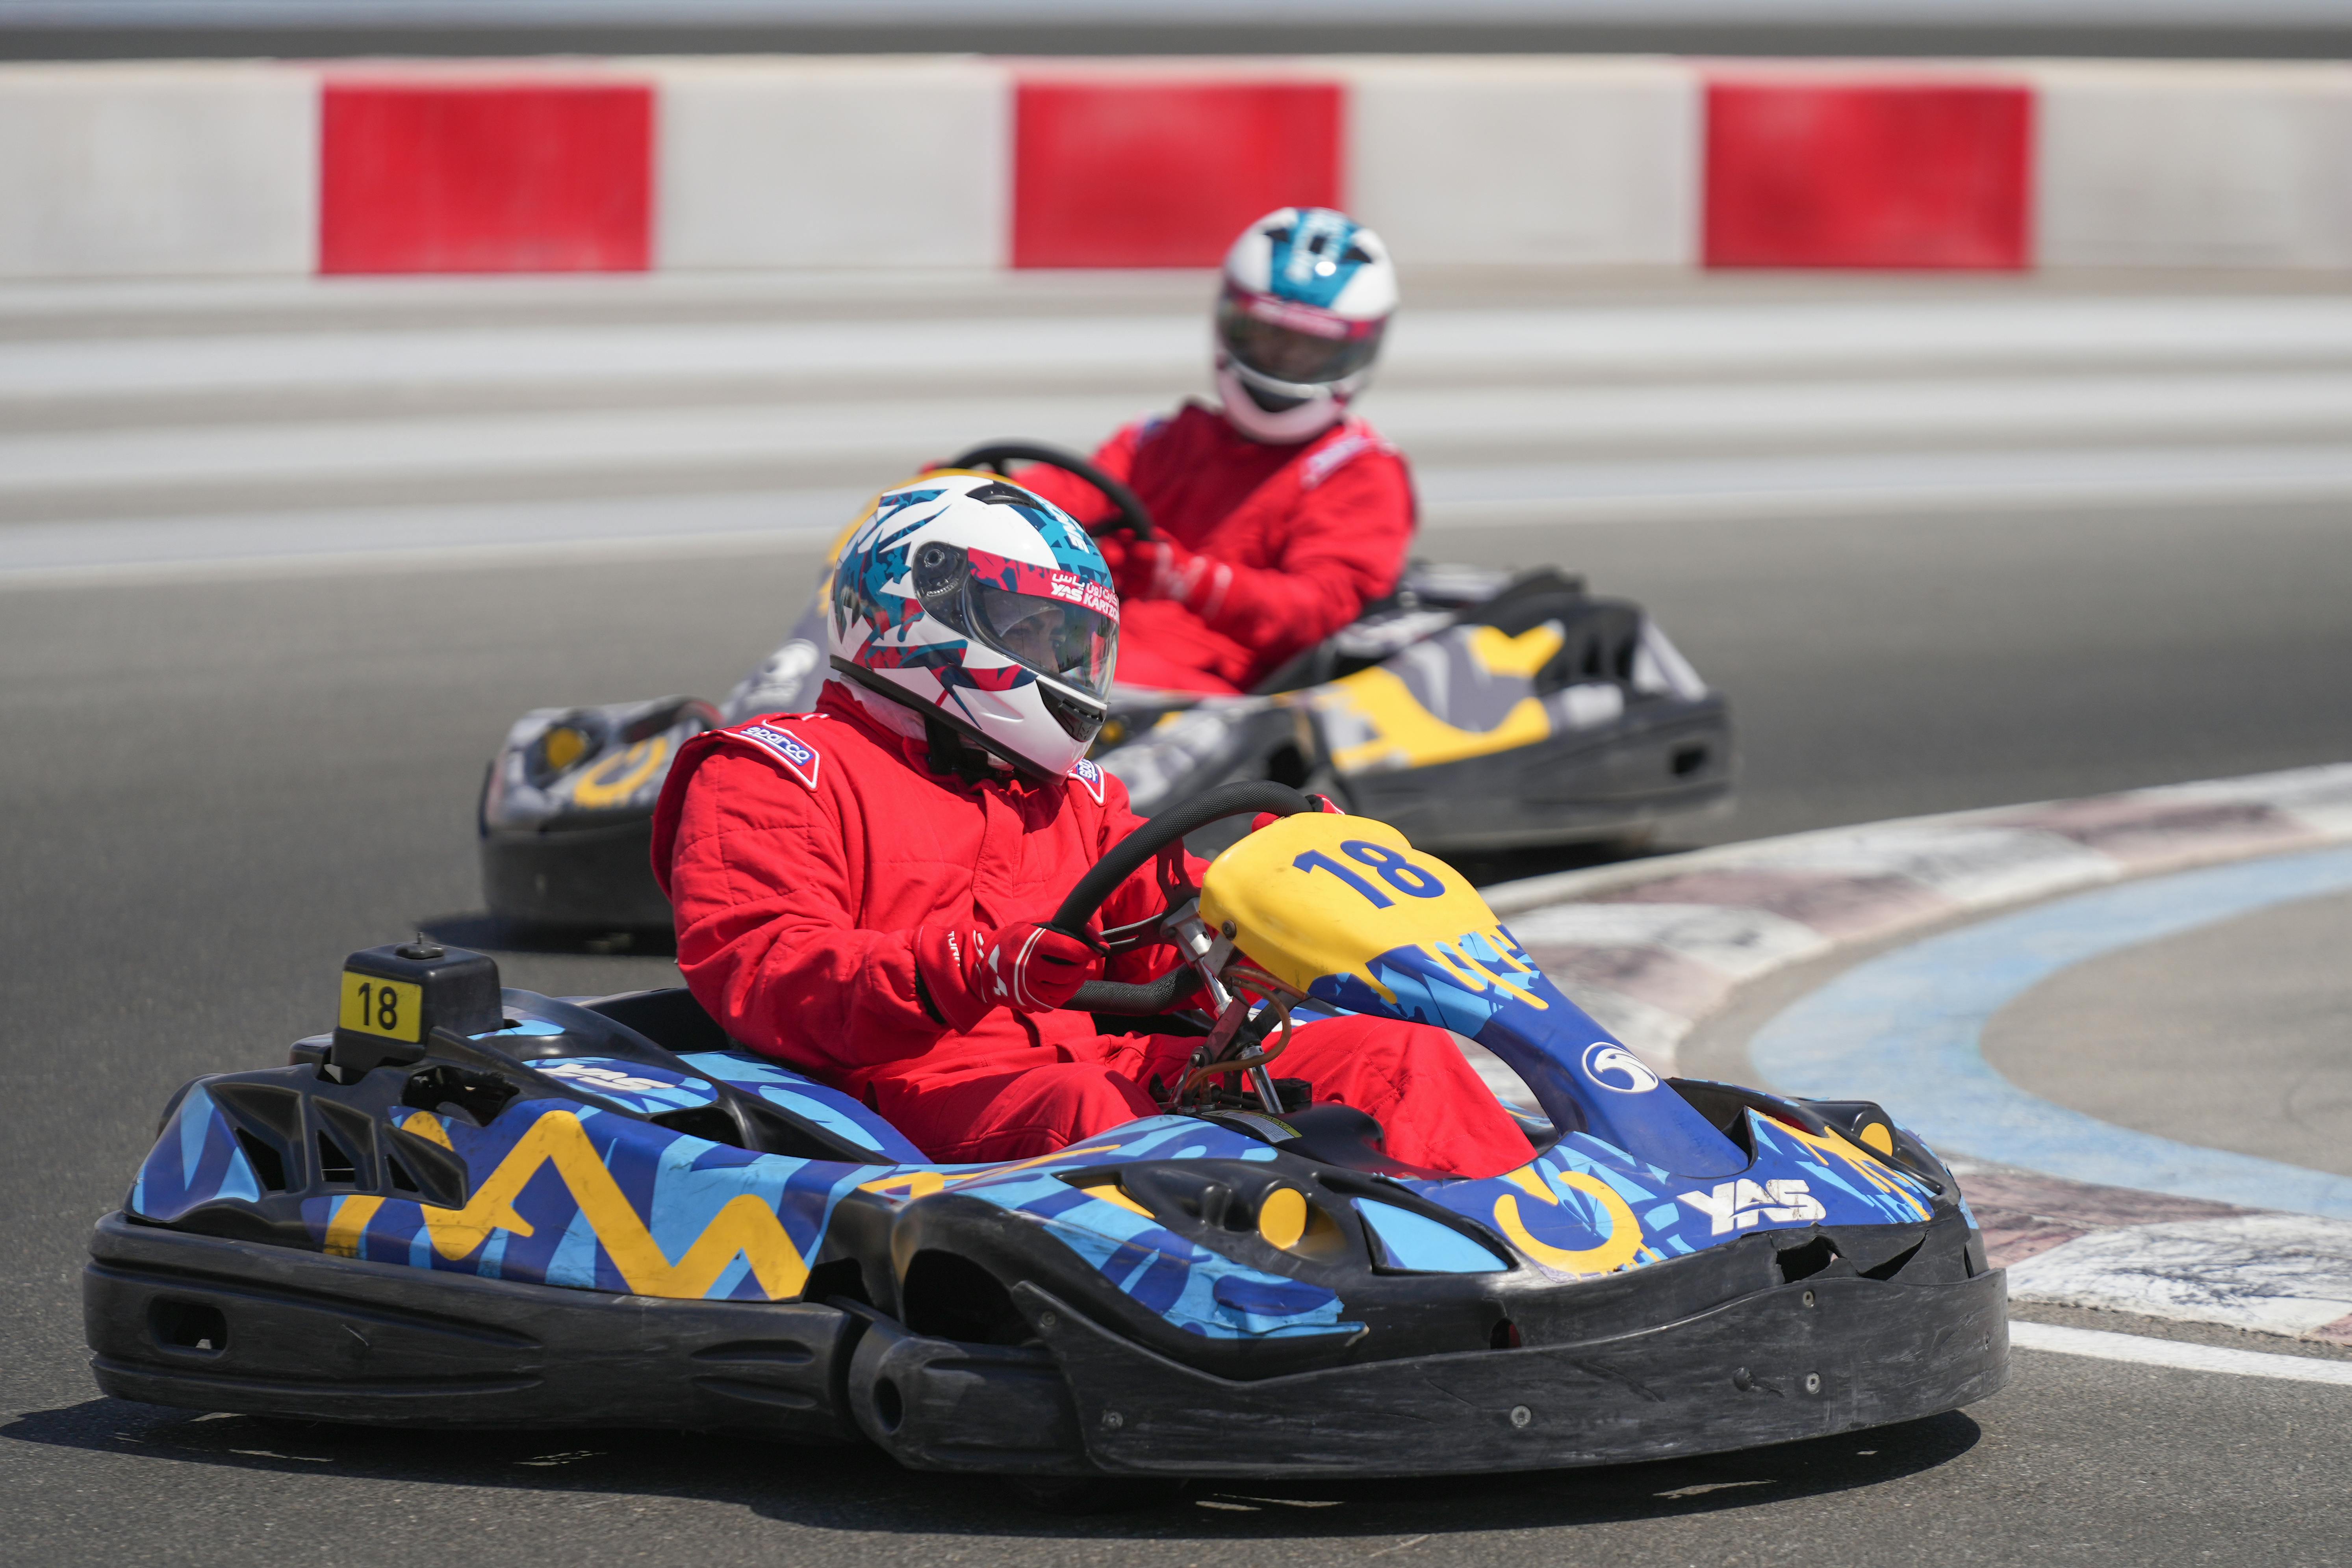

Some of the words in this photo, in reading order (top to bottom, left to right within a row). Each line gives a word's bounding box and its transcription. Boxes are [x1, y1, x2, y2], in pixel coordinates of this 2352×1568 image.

[1051, 582, 1083, 602] YAS
[1083, 592, 1119, 622] KARTZO
[1052, 573, 1085, 591] ياس
[741, 726, 811, 761] sparco
[1292, 839, 1446, 909] 18
[358, 982, 397, 1030] 18
[534, 1063, 676, 1091] YAS
[1676, 1178, 1827, 1236] YAS
